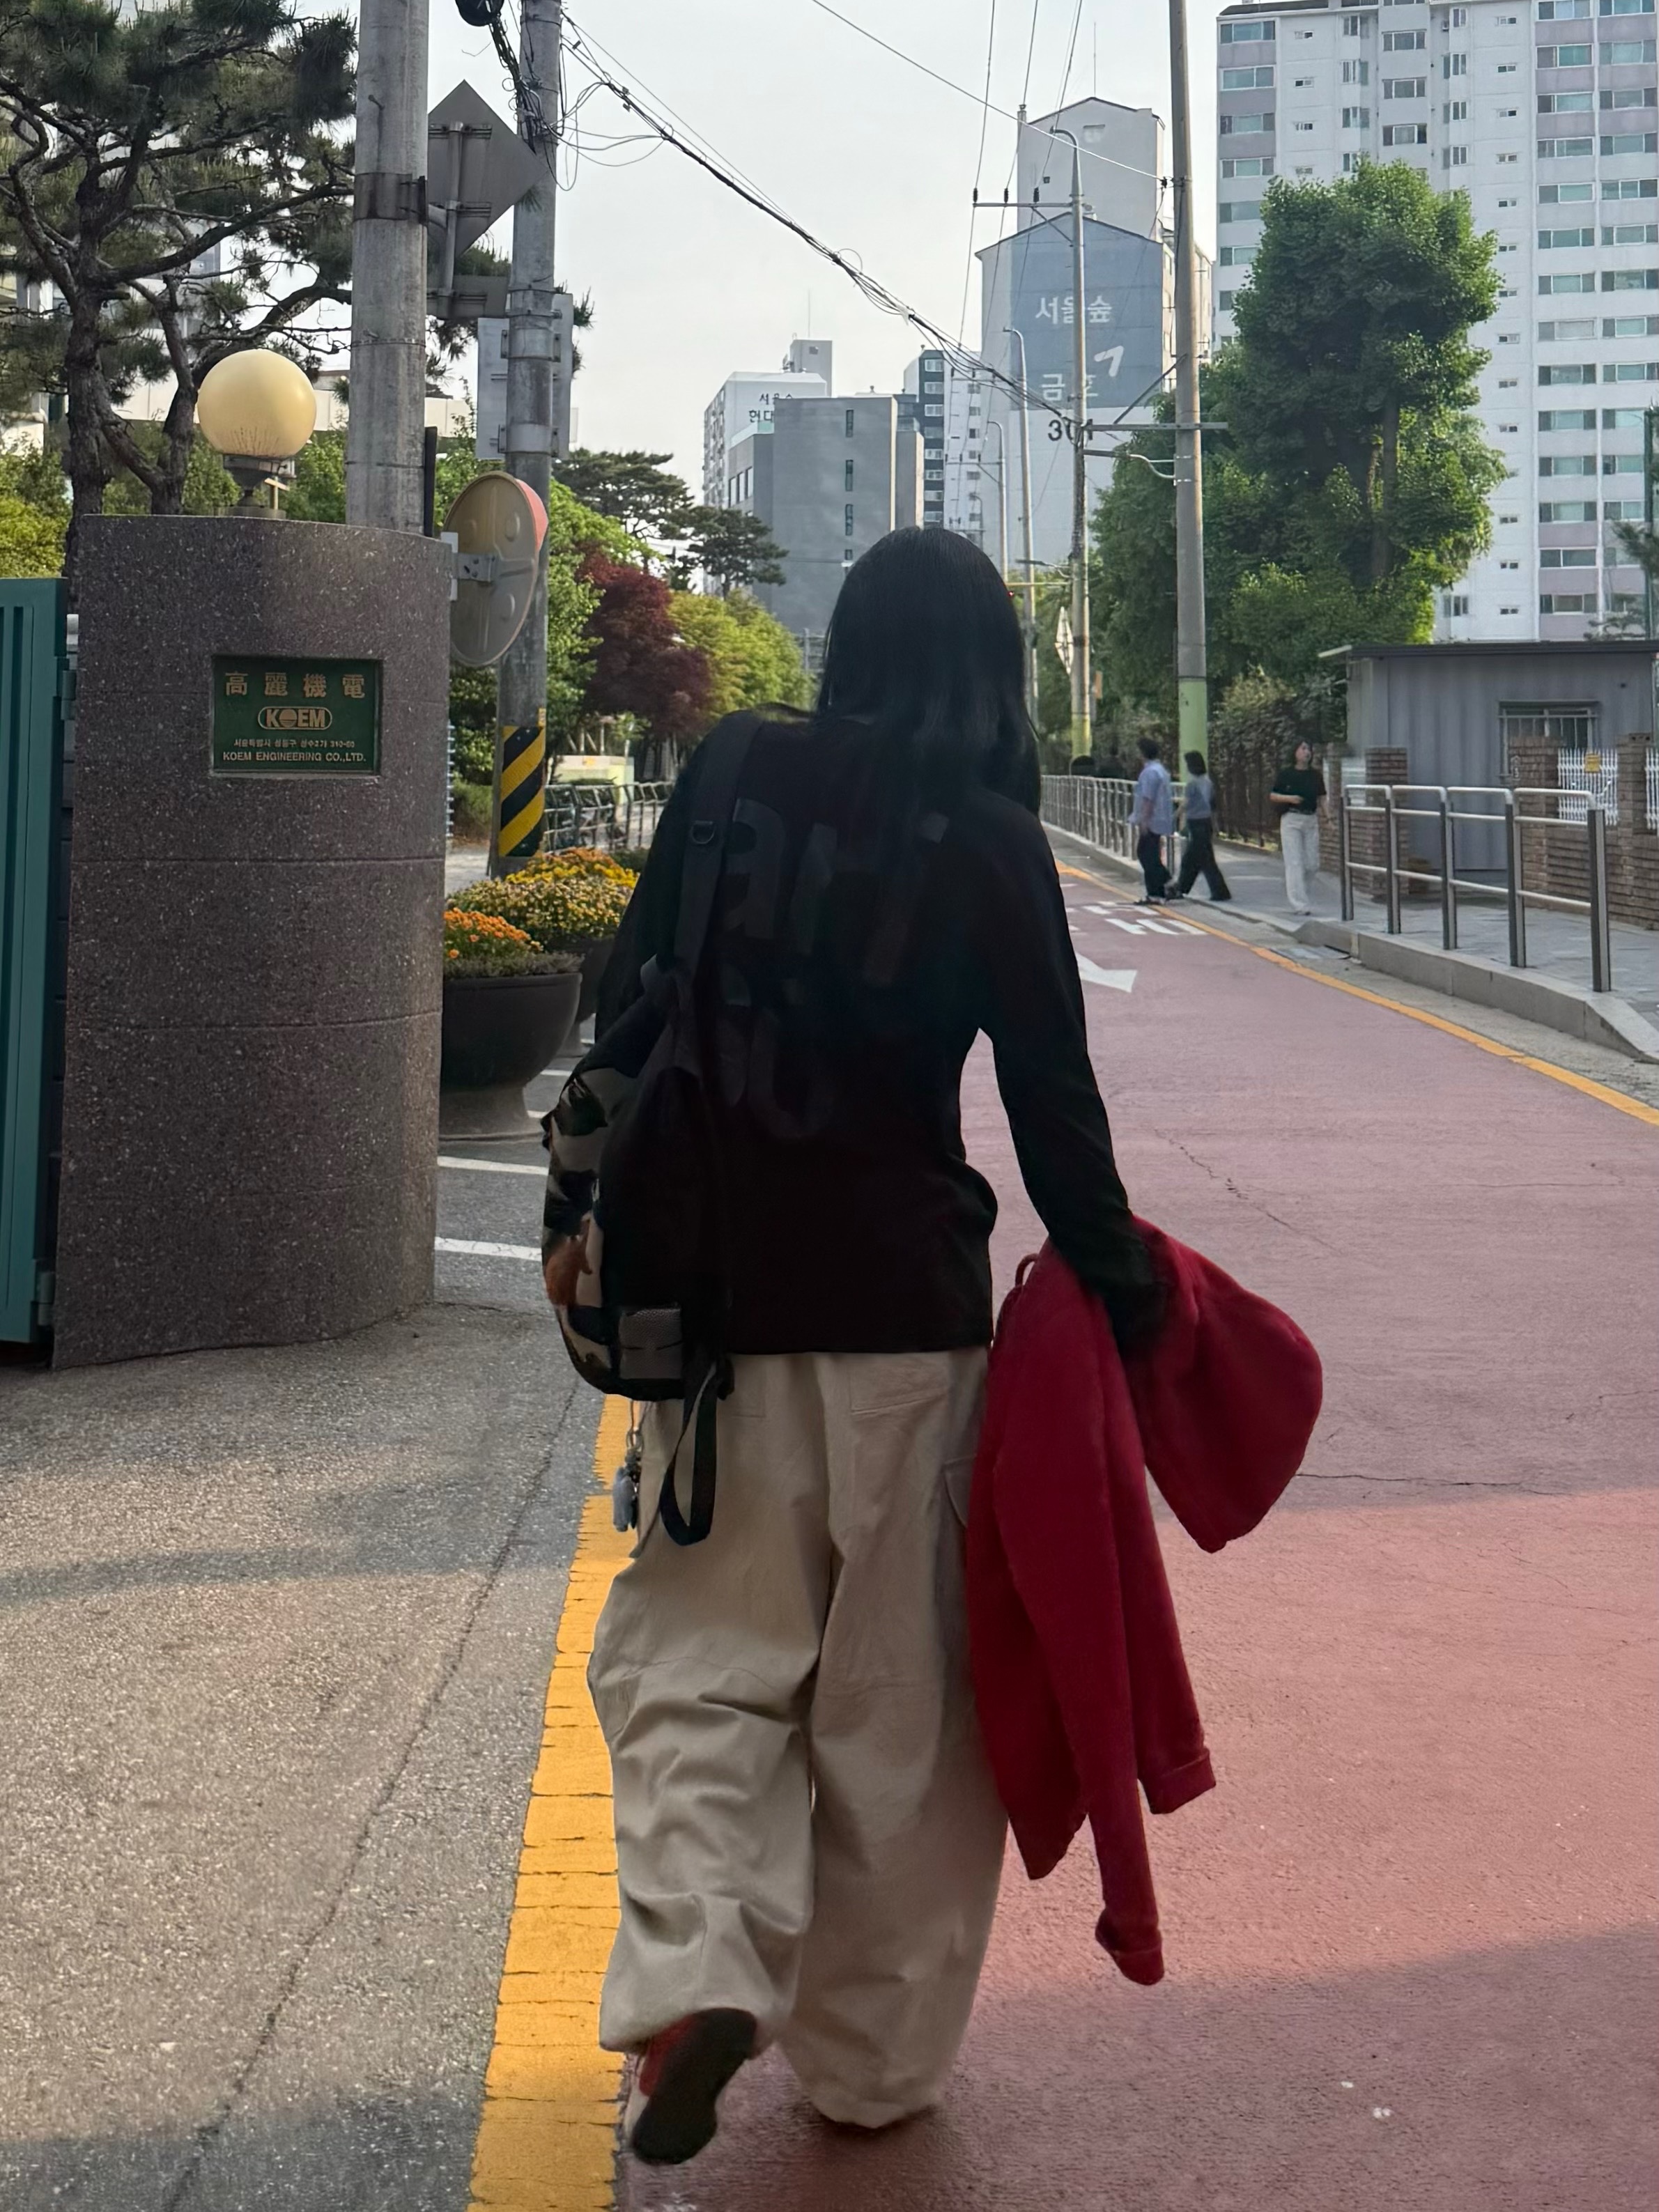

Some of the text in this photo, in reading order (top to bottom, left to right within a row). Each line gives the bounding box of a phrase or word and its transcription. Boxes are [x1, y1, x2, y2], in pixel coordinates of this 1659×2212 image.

[266, 708, 326, 728] KOEM
[223, 751, 252, 761] KOEM
[256, 752, 322, 761] ENGINEERING
